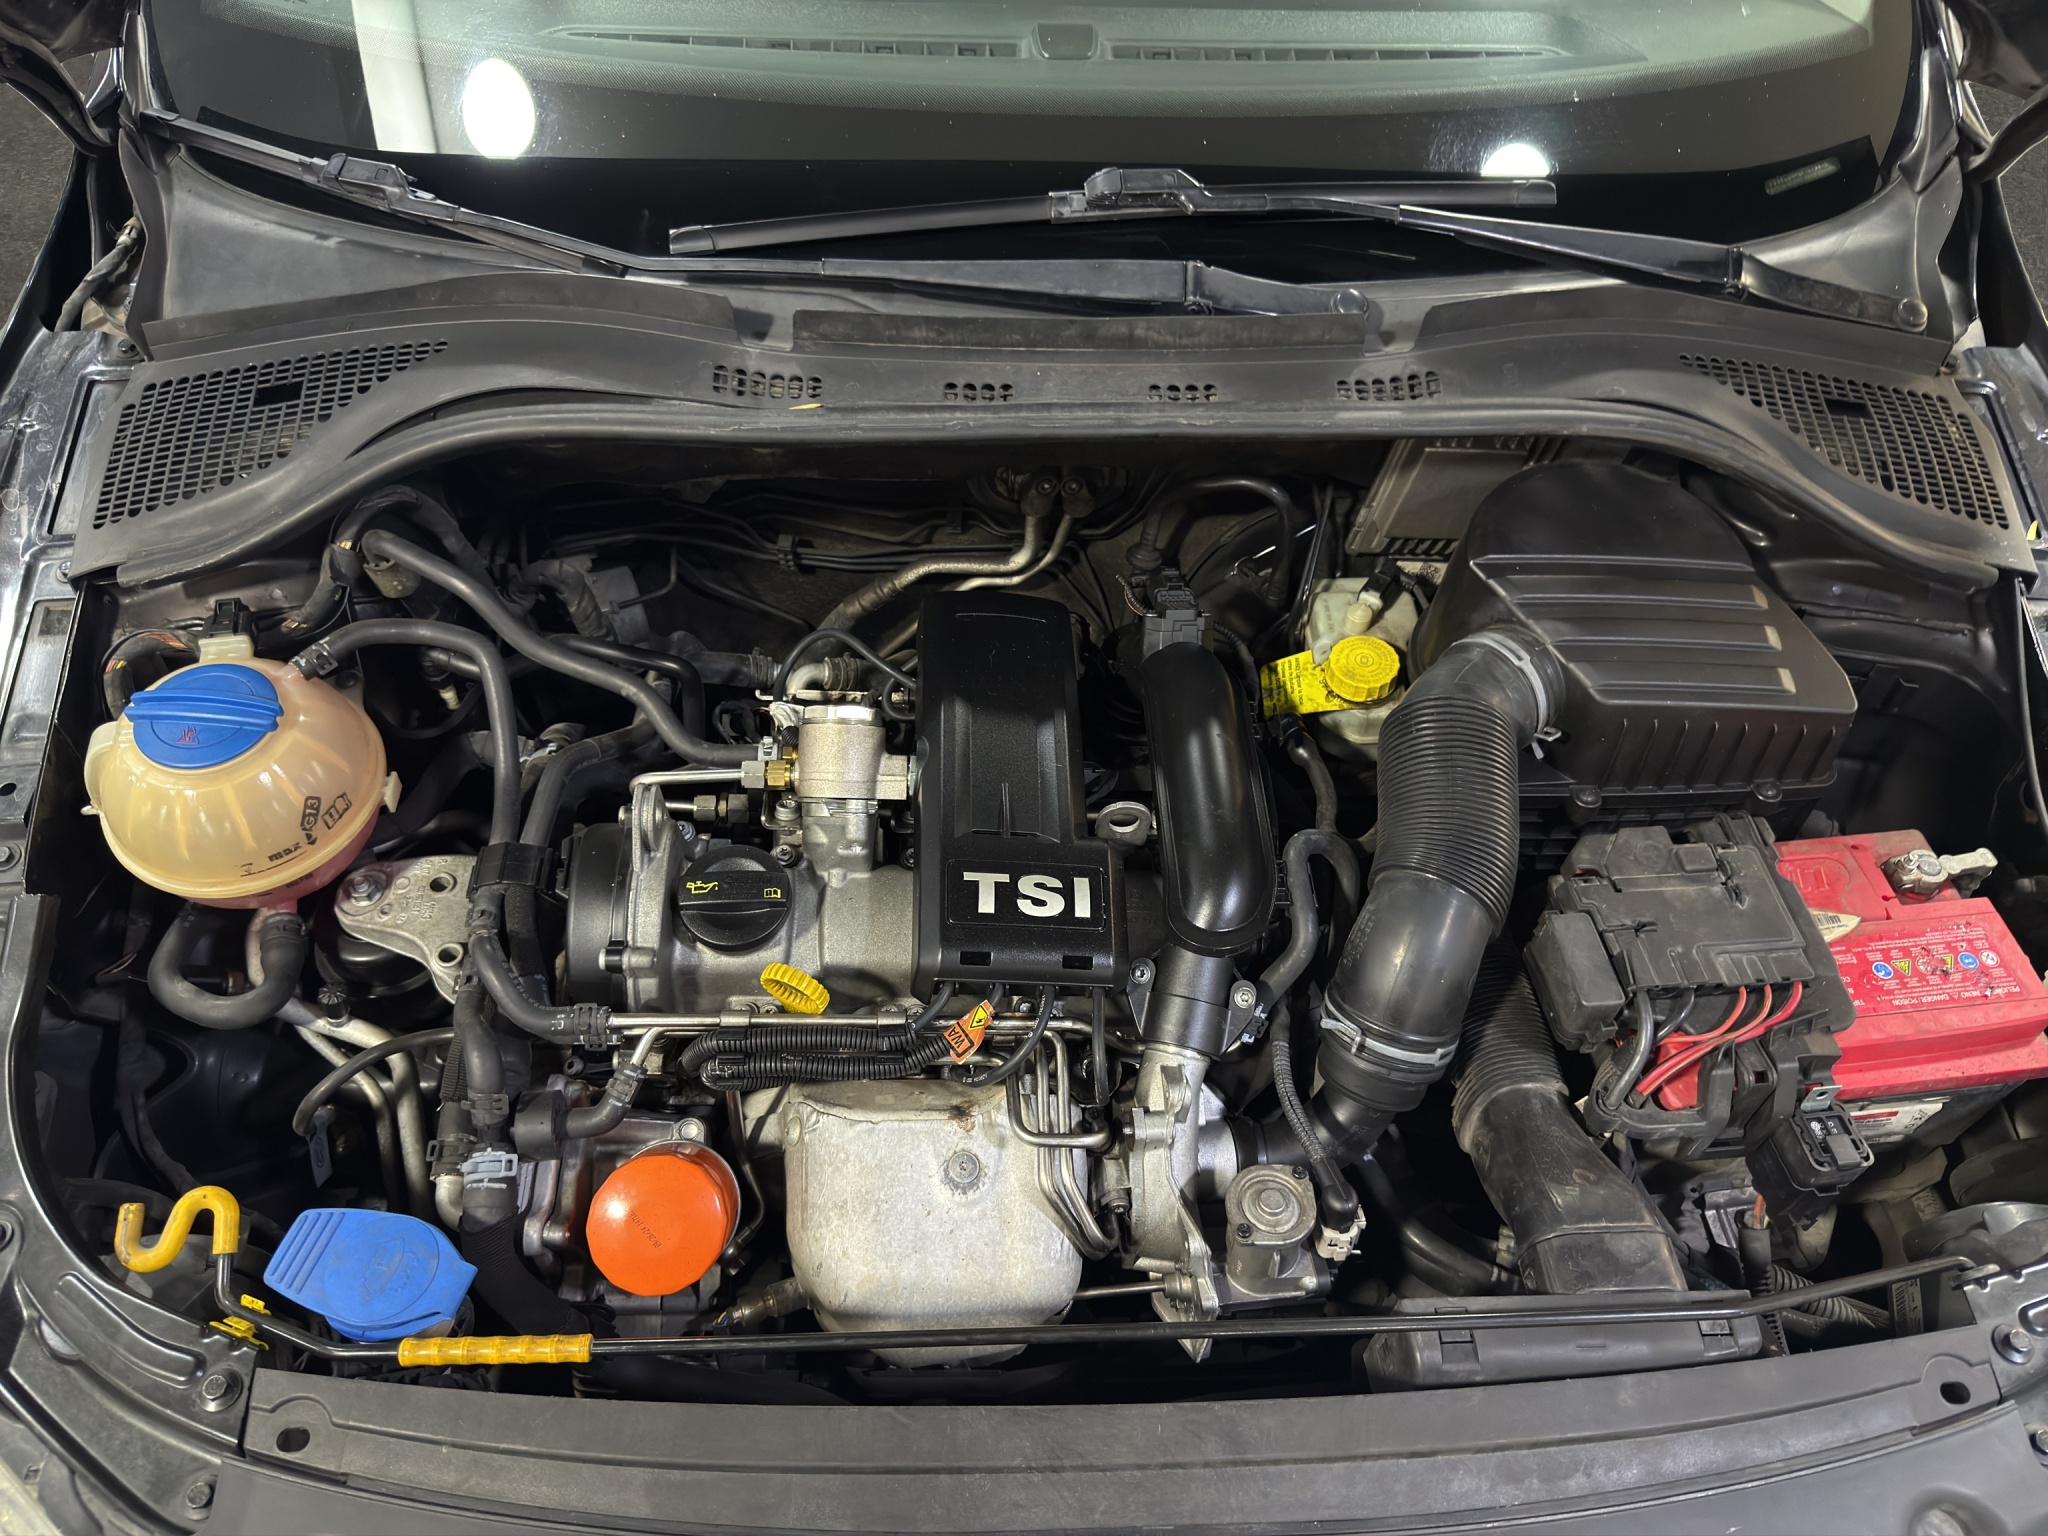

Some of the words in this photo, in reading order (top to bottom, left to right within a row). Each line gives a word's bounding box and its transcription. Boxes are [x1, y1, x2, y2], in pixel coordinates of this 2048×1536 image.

[305, 799, 318, 829] G13
[268, 842, 302, 862] max
[962, 872, 1091, 919] TSI
